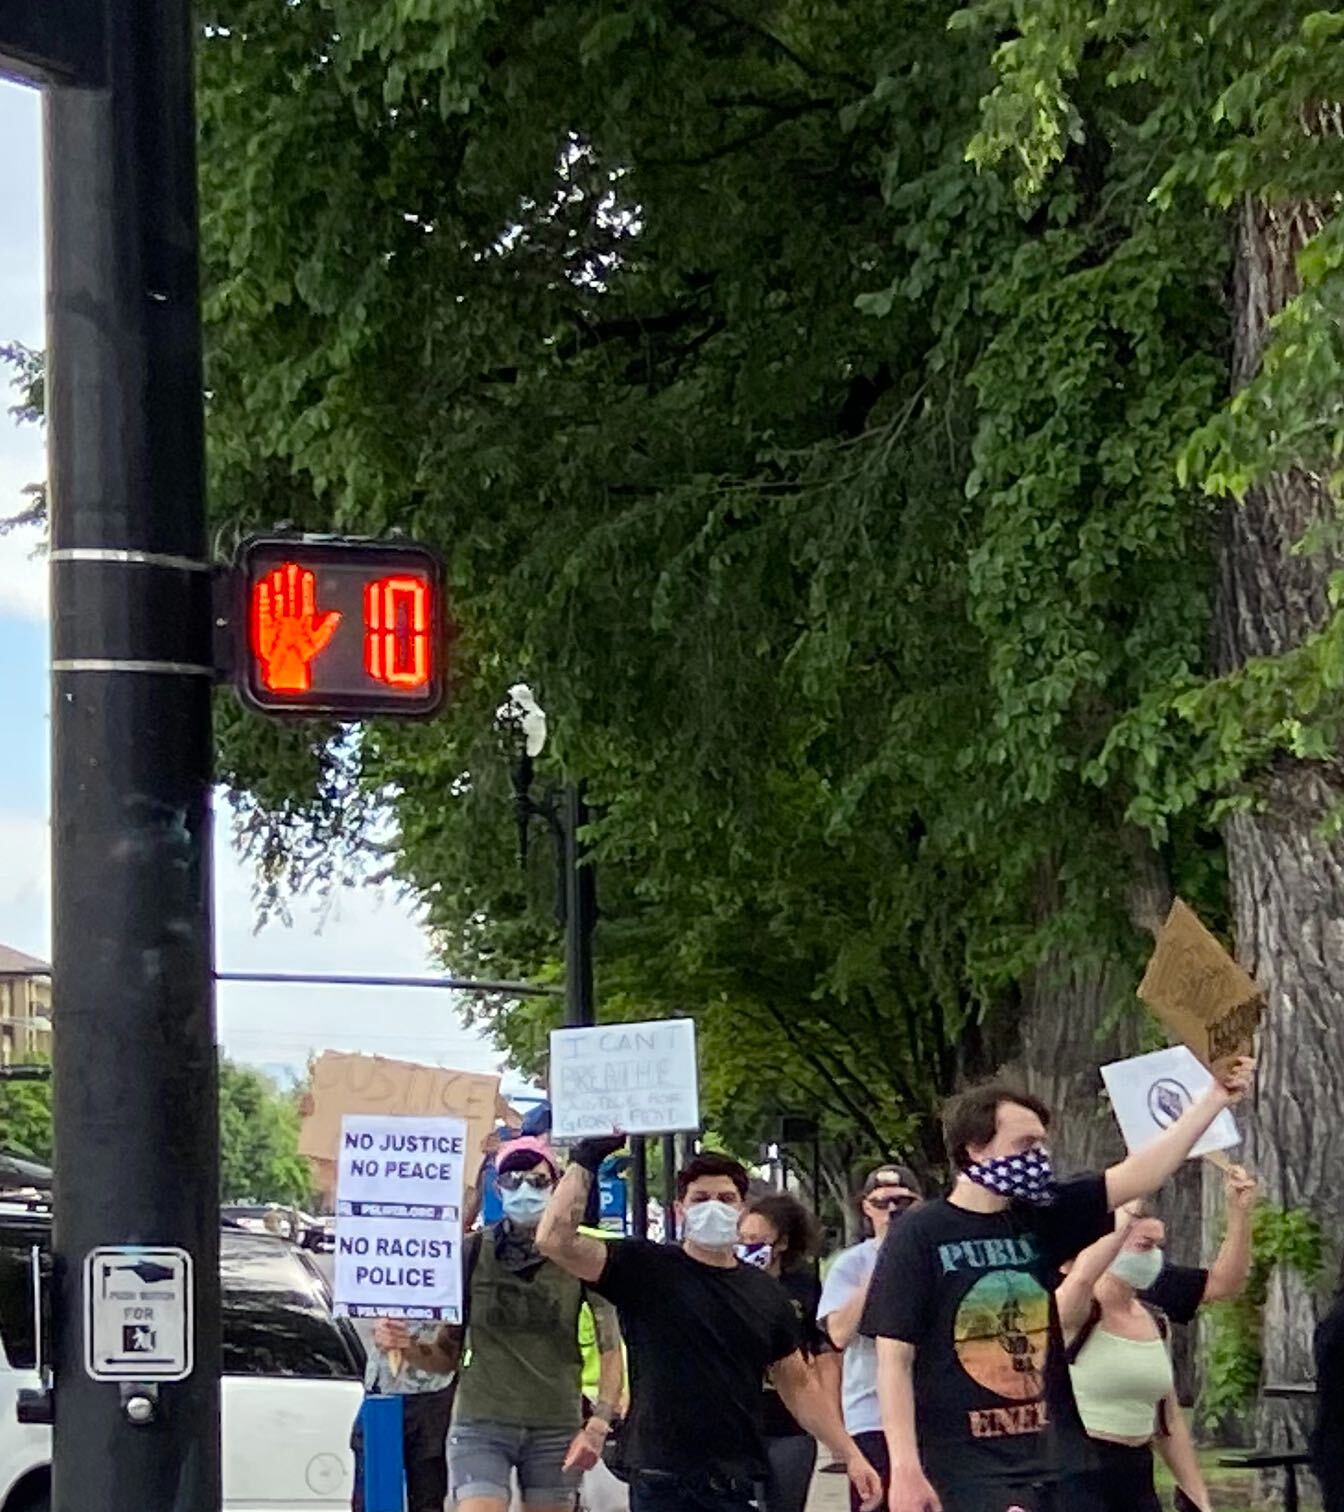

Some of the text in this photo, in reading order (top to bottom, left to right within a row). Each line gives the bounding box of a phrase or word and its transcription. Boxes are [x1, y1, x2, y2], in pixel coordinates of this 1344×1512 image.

[365, 577, 429, 686] 10
[345, 1132, 464, 1154] NO JUSTICE
[351, 1160, 452, 1180] NO PEACE
[340, 1237, 453, 1259] NO RACIST
[356, 1266, 436, 1288] POLICE
[124, 1307, 153, 1320] FOR
